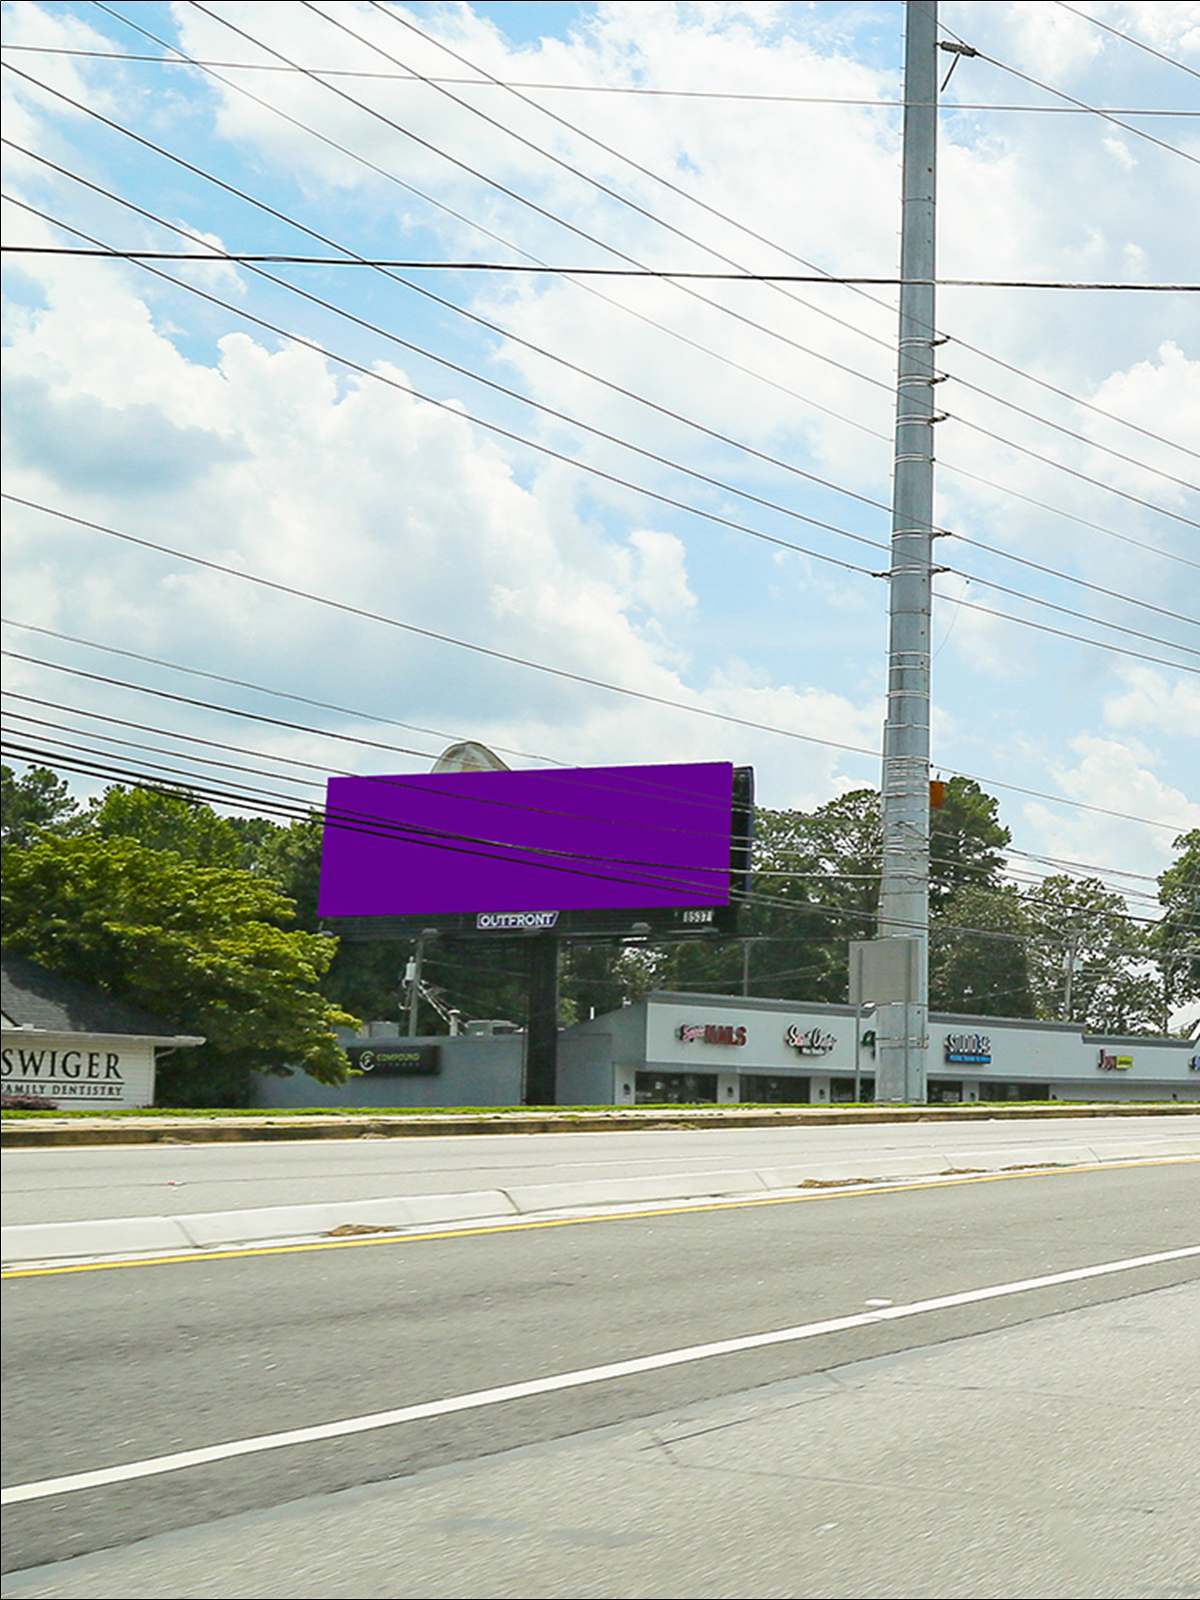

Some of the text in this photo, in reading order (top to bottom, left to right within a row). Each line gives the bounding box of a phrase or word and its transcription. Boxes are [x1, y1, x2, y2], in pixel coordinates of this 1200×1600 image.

[480, 913, 554, 927] OUTFRONT
[704, 1024, 748, 1047] NAILS
[1, 1048, 123, 1079] SWIGER
[52, 1084, 122, 1096] DENTISTRY
